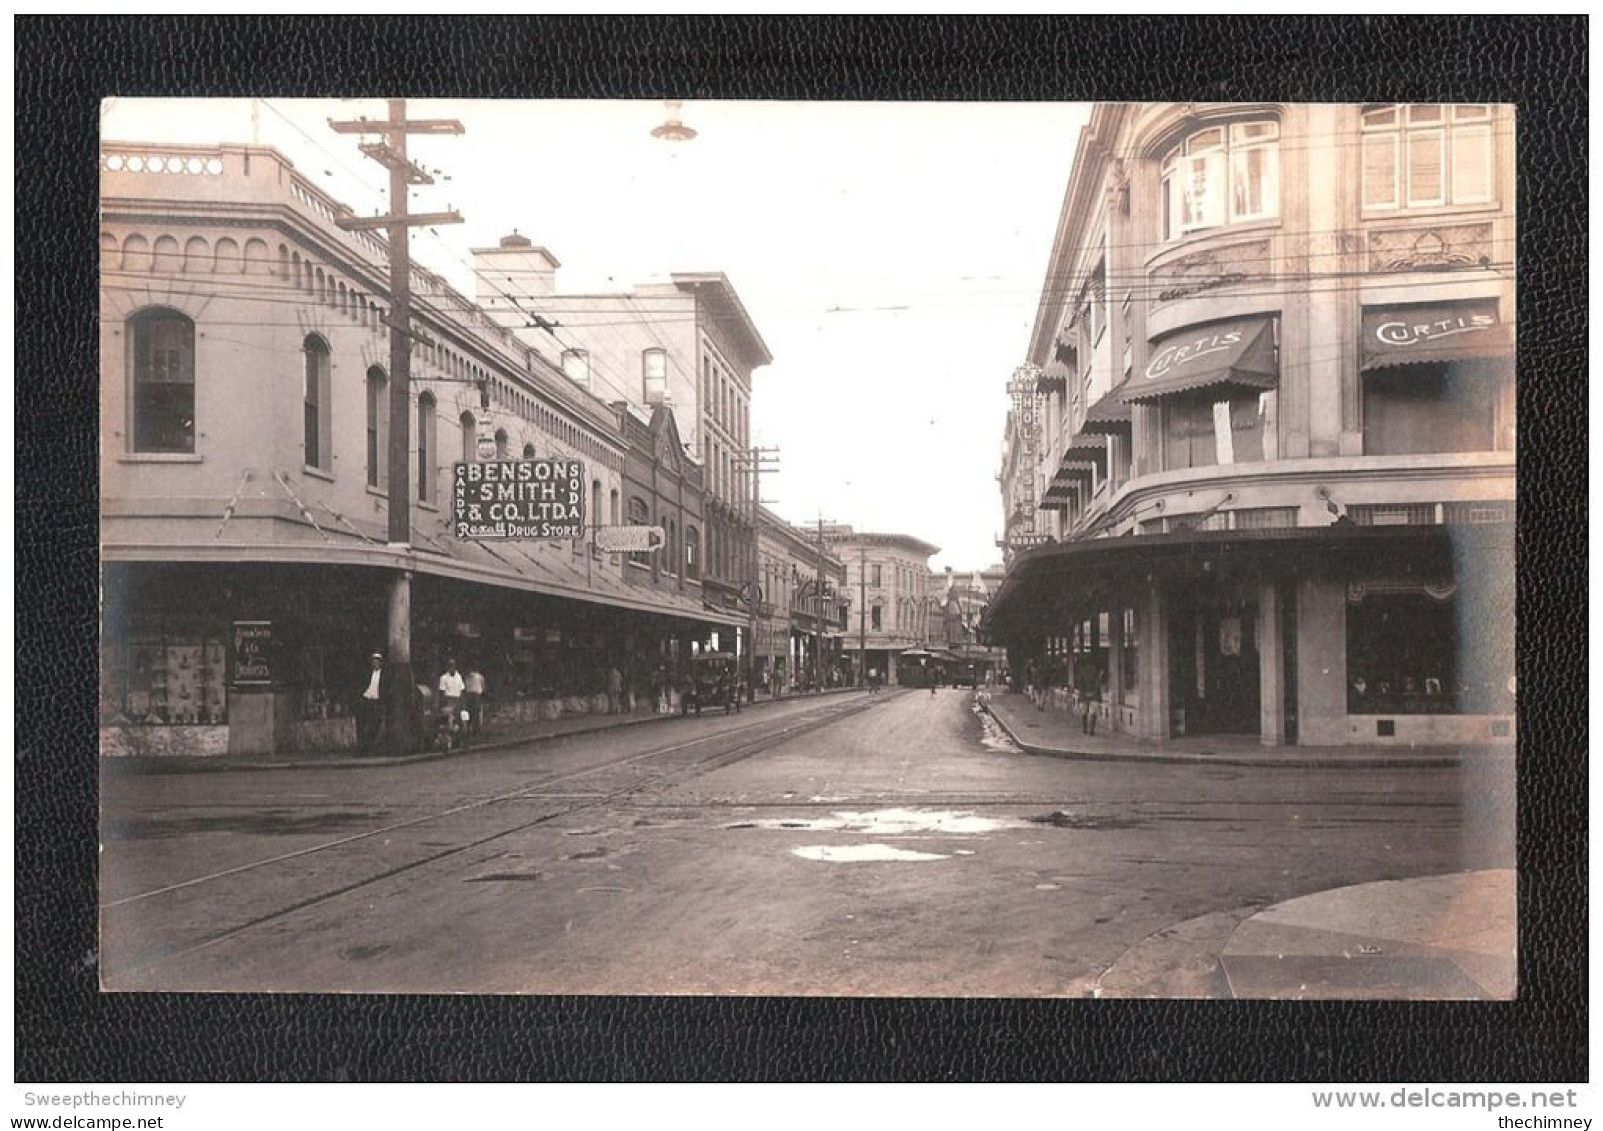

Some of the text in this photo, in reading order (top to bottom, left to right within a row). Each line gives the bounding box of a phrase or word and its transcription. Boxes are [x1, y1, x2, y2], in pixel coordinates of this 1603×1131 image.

[467, 463, 568, 482] BENSON
[455, 466, 466, 520] CANDY
[480, 482, 556, 501] SMITH
[568, 464, 580, 519] SODA
[467, 503, 483, 520] &
